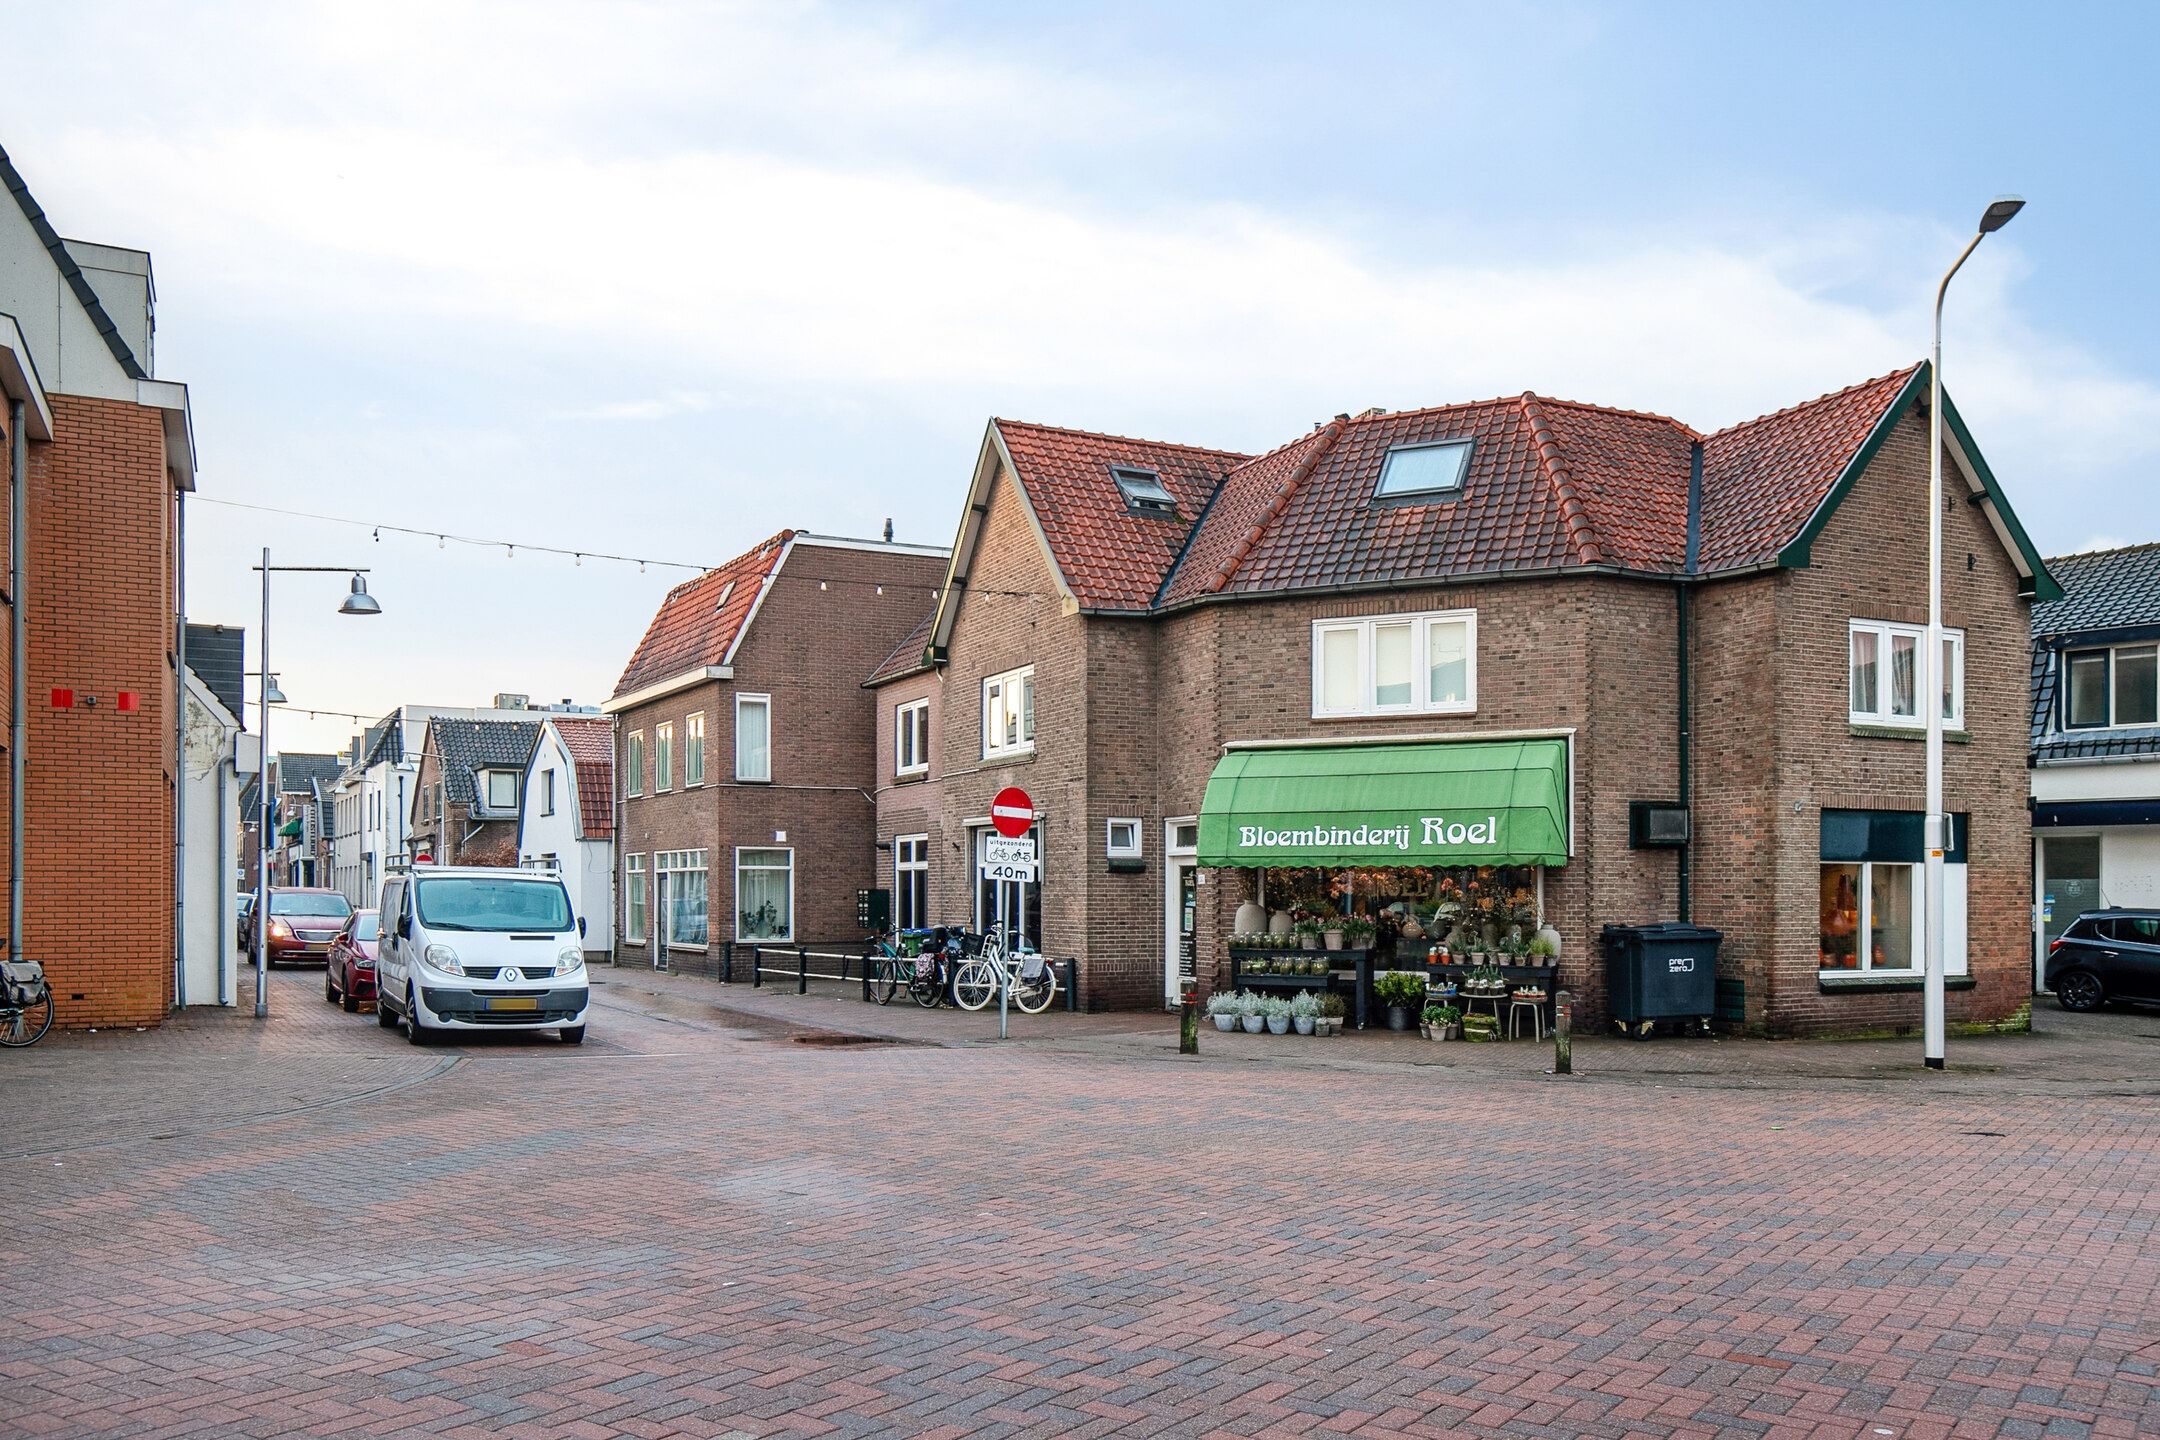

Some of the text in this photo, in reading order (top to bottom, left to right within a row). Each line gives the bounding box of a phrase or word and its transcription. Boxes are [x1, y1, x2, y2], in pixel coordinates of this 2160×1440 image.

[1238, 816, 1497, 850] Bloembinderij Roel
[993, 866, 1027, 879] 40m
